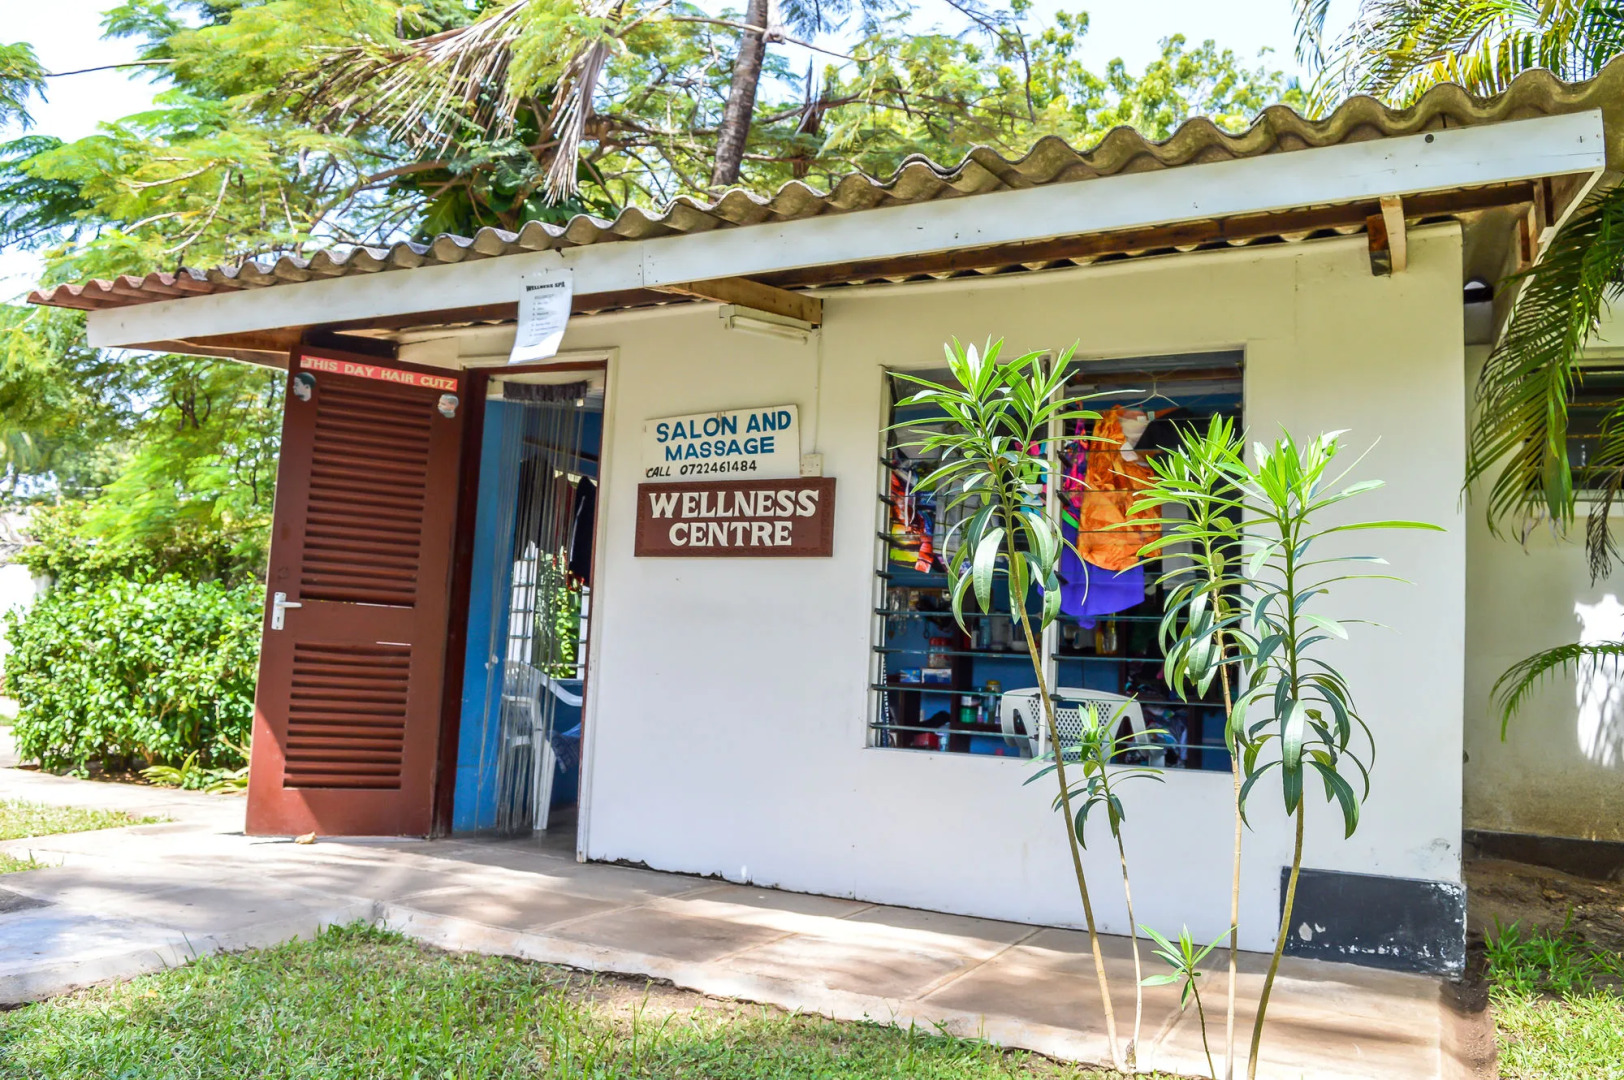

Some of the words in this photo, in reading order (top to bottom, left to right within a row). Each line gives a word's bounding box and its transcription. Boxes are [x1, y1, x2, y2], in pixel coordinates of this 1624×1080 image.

[305, 357, 338, 371] THIS
[344, 364, 375, 377] DAY
[381, 370, 414, 384] HAIR
[420, 376, 455, 390] CUTZ
[656, 415, 738, 443] SALON
[746, 410, 792, 433] AND
[665, 436, 775, 462] MASSAGE
[646, 466, 671, 478] CALL
[680, 460, 757, 476] 0722461484
[649, 490, 819, 519] WELLNESS
[668, 521, 793, 547] CENTRE
